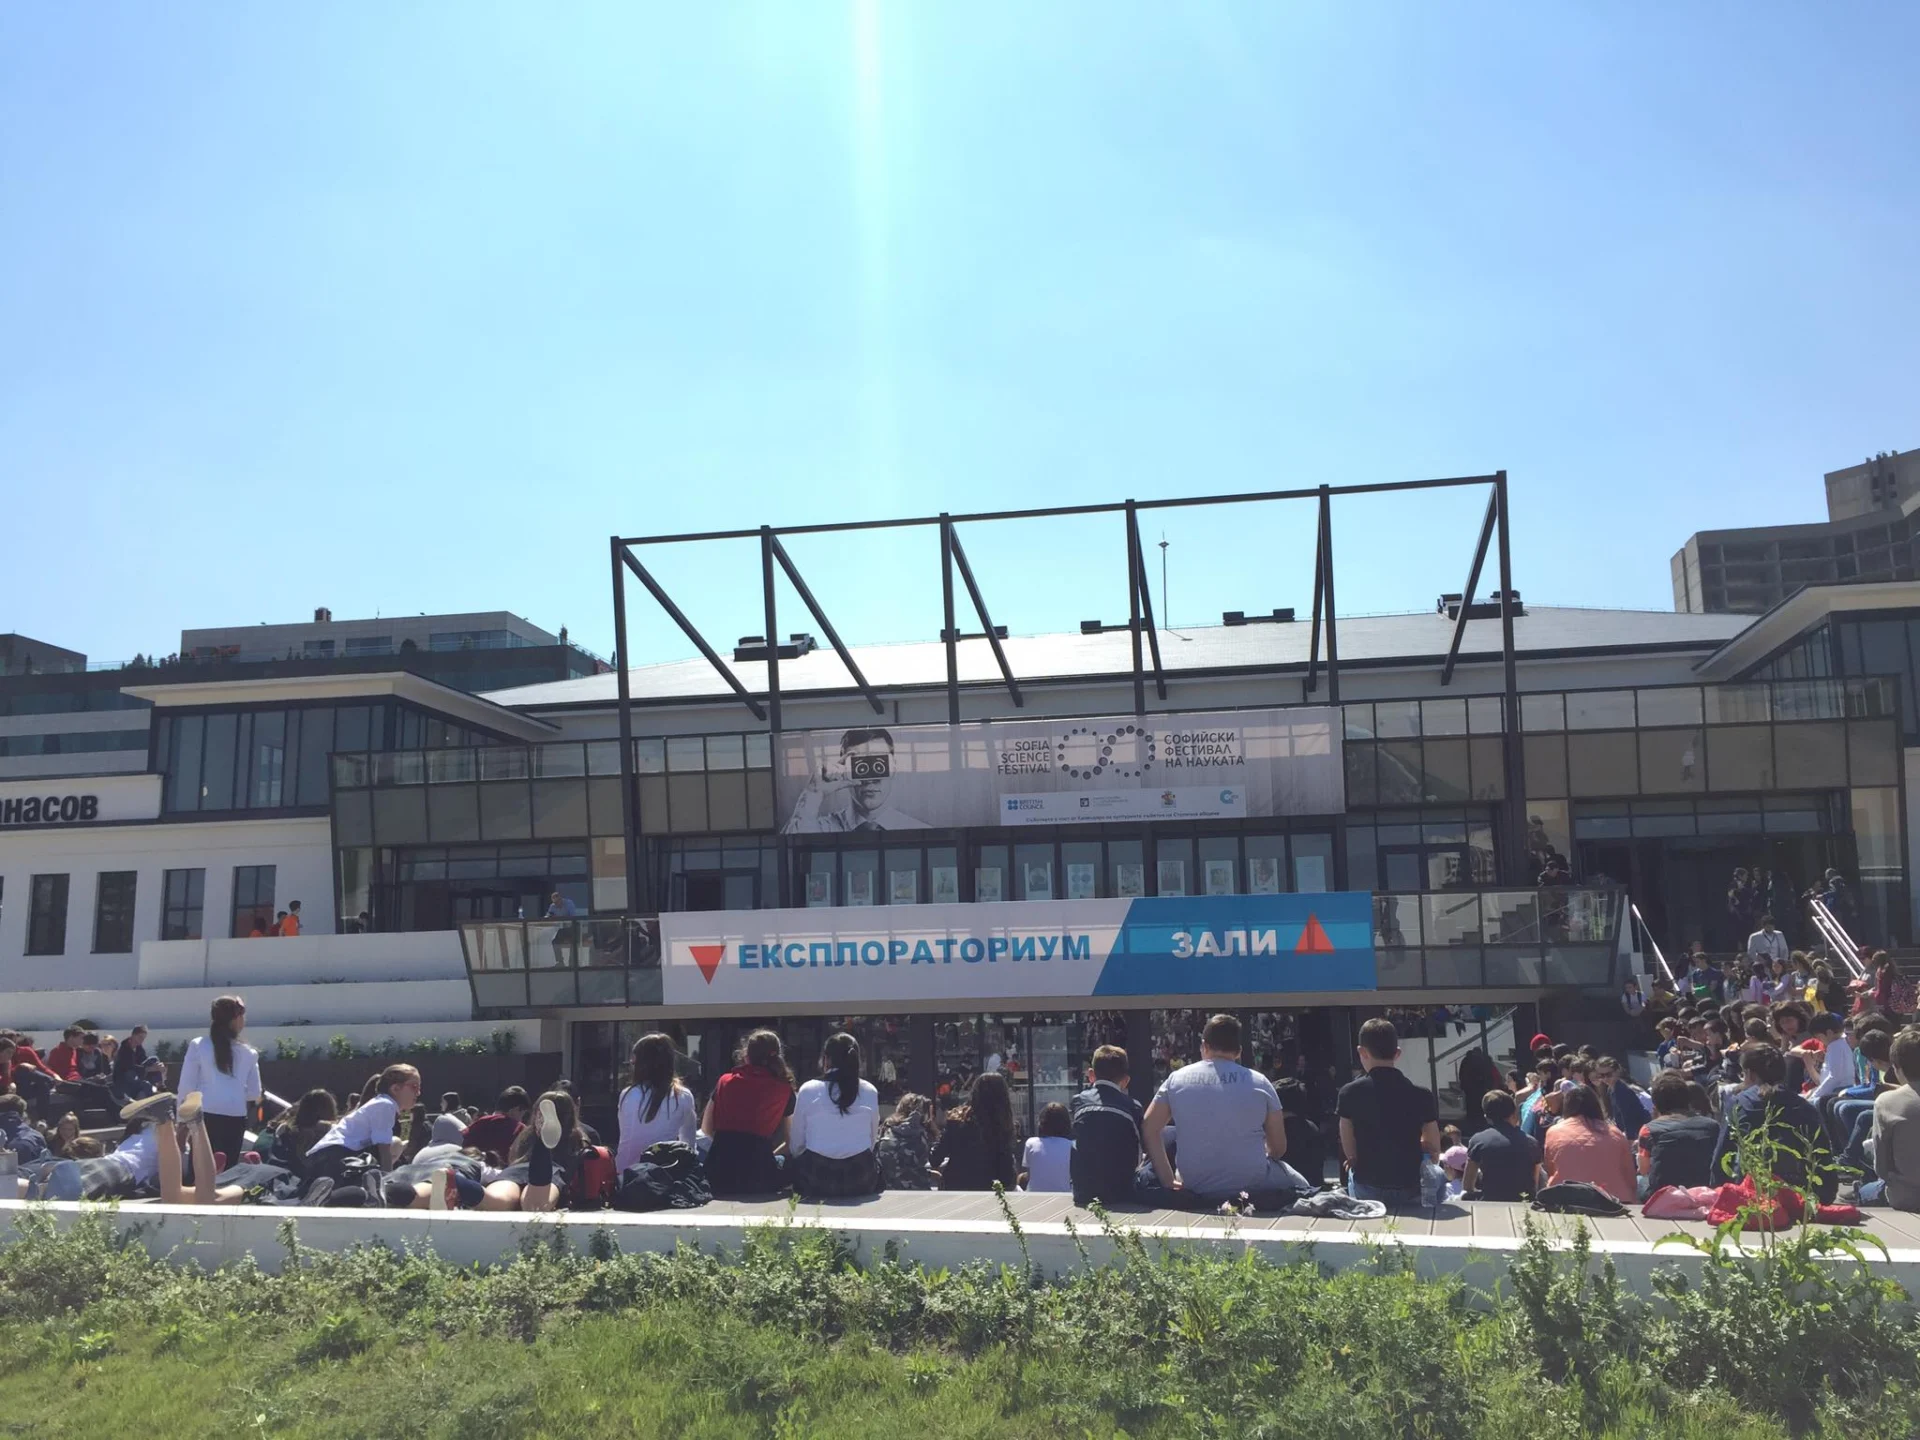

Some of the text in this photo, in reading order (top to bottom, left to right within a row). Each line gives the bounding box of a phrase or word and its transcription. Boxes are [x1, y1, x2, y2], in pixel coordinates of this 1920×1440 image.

[1164, 731, 1235, 745] СОФИЙСКИ
[1015, 740, 1050, 751] SOFIA
[1165, 744, 1232, 756] ФЕСТИВАЛ
[1001, 751, 1050, 764] SCIENCE
[1165, 755, 1245, 768] НА НАУКАТА
[997, 763, 1051, 775] FESTIVAL
[0, 795, 98, 824] насов
[738, 929, 1277, 968] ЕКСПЛОРАТОРИУМ ЗАЛИ
[1183, 1071, 1248, 1086] GERMANY
